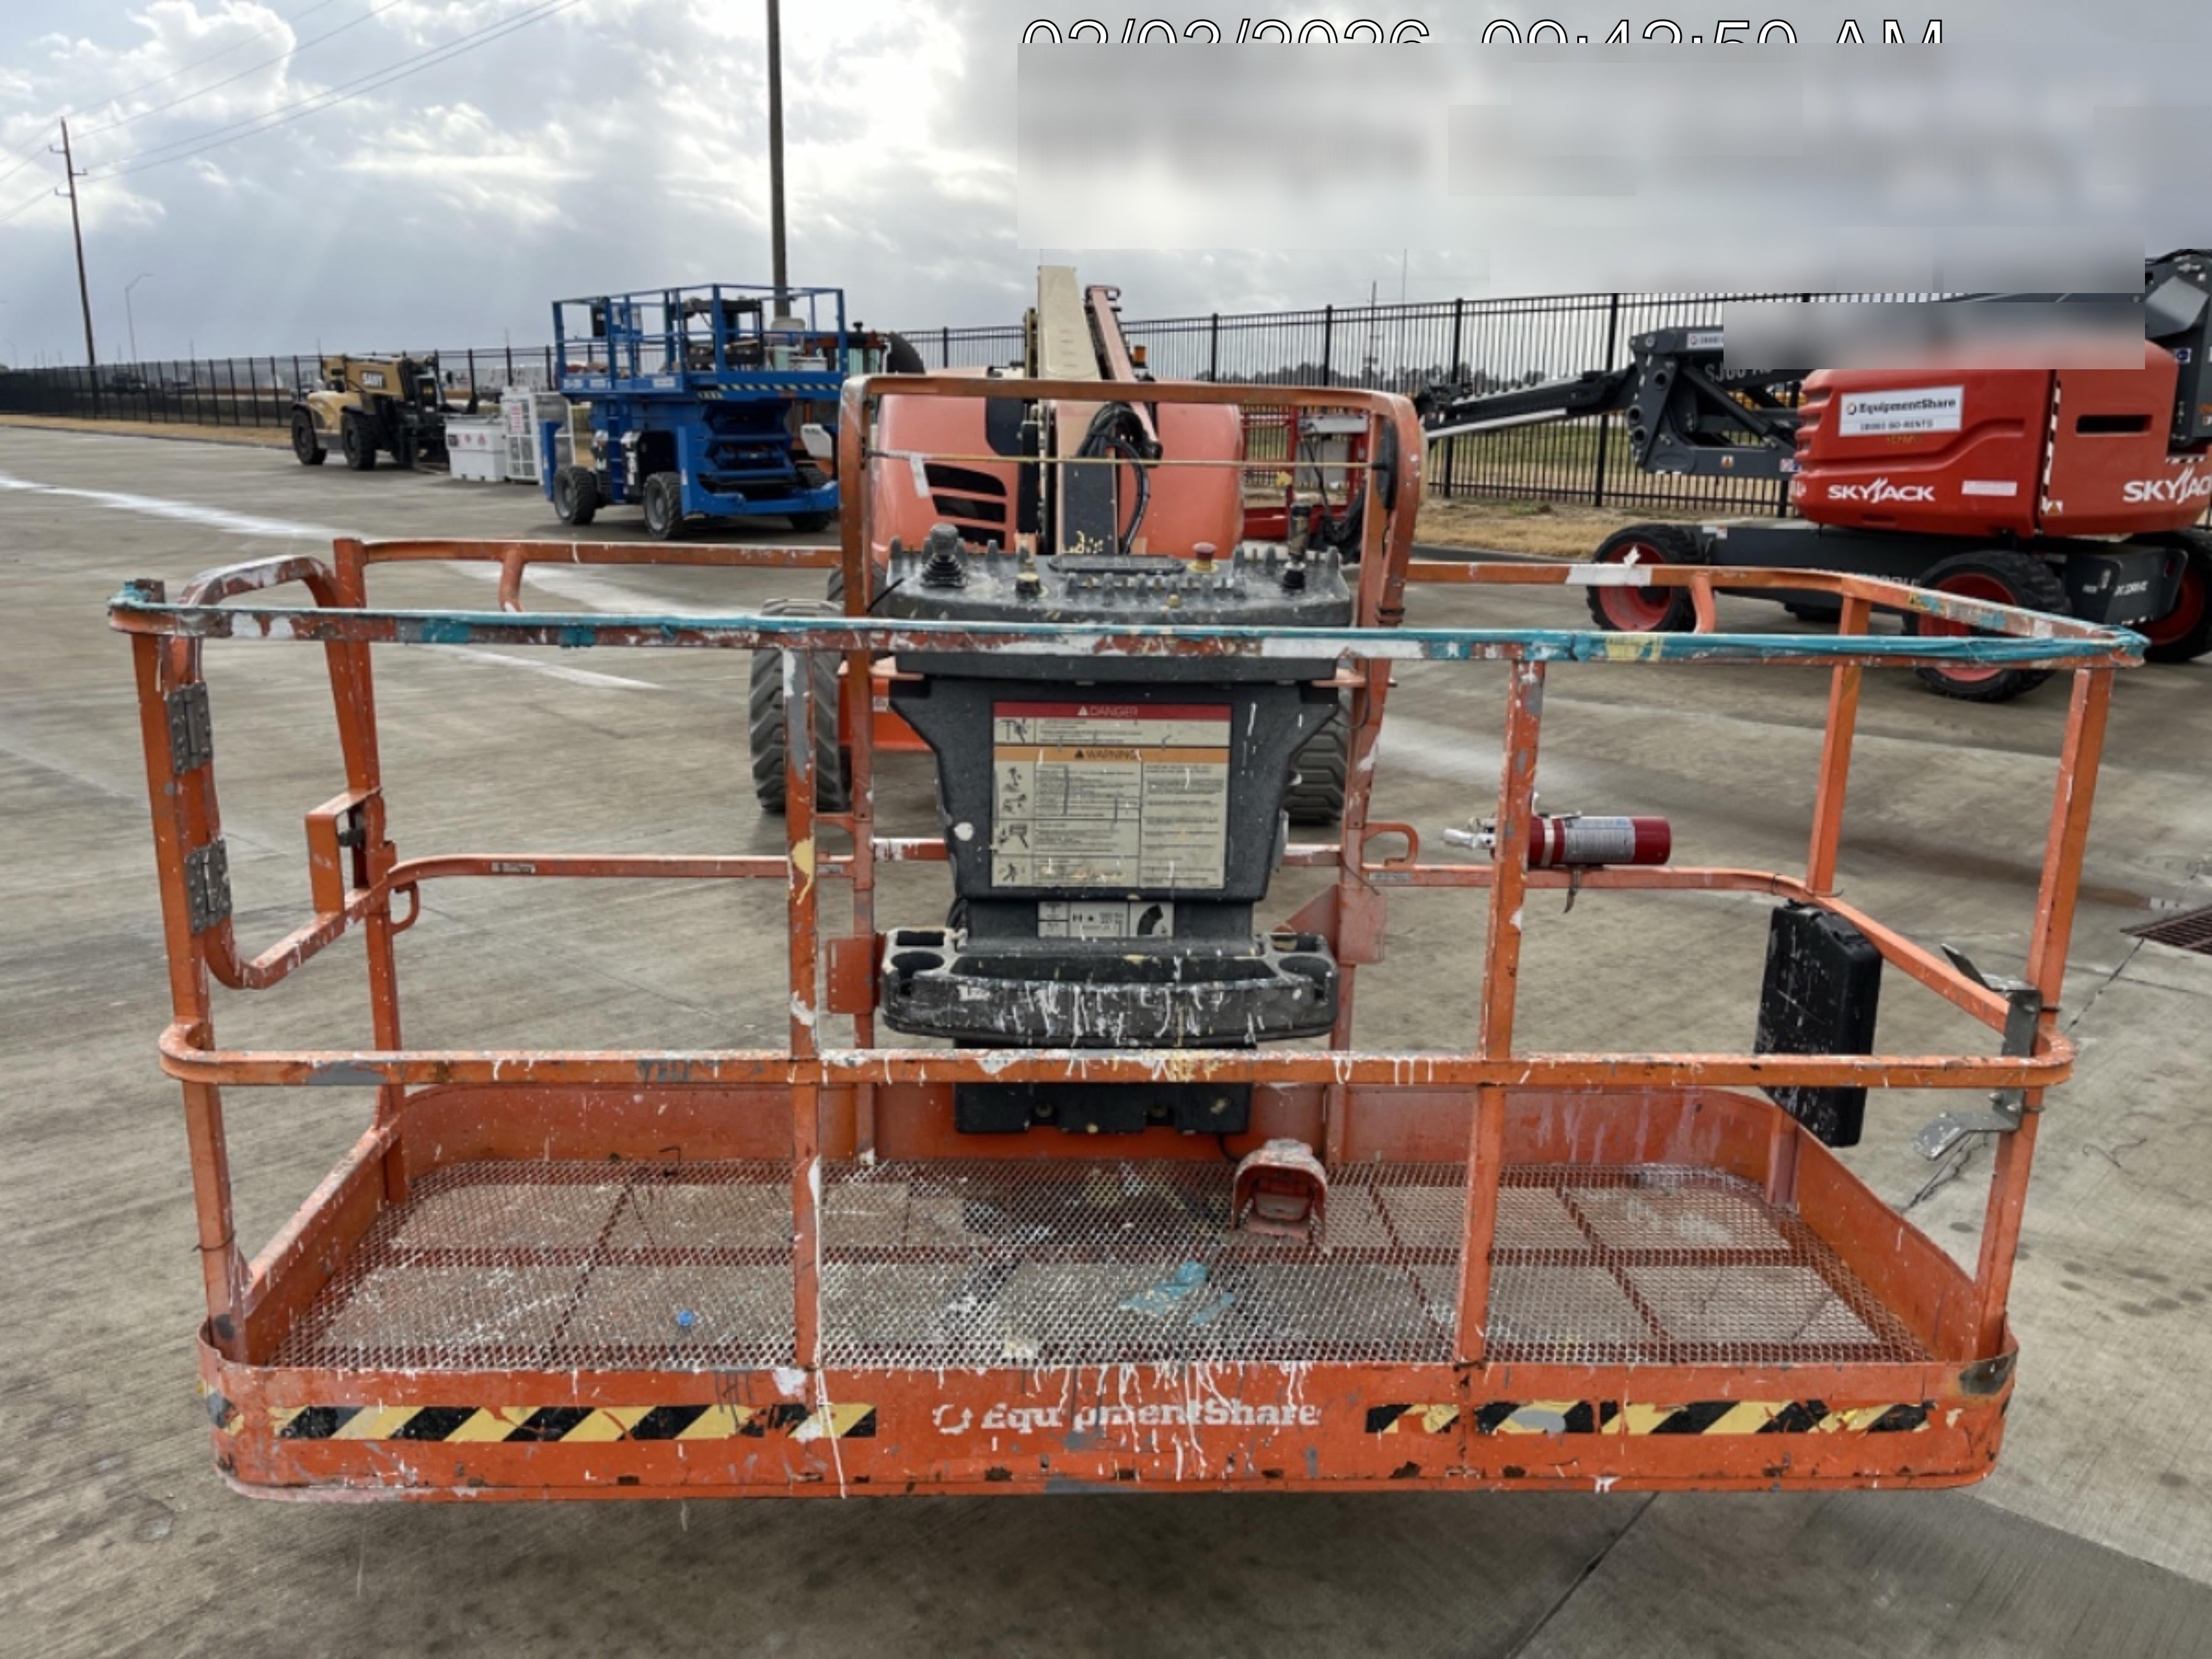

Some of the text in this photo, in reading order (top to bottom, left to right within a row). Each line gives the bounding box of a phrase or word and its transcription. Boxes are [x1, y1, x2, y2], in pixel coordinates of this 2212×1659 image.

[1859, 398, 1956, 415] EquipmentShare
[1827, 477, 1936, 504] SKYJACK
[2123, 466, 2212, 504] SKYJAC
[1090, 705, 1138, 718] DANGER
[1085, 749, 1137, 760] WARNING
[981, 1398, 1318, 1433] EqupmentShare
